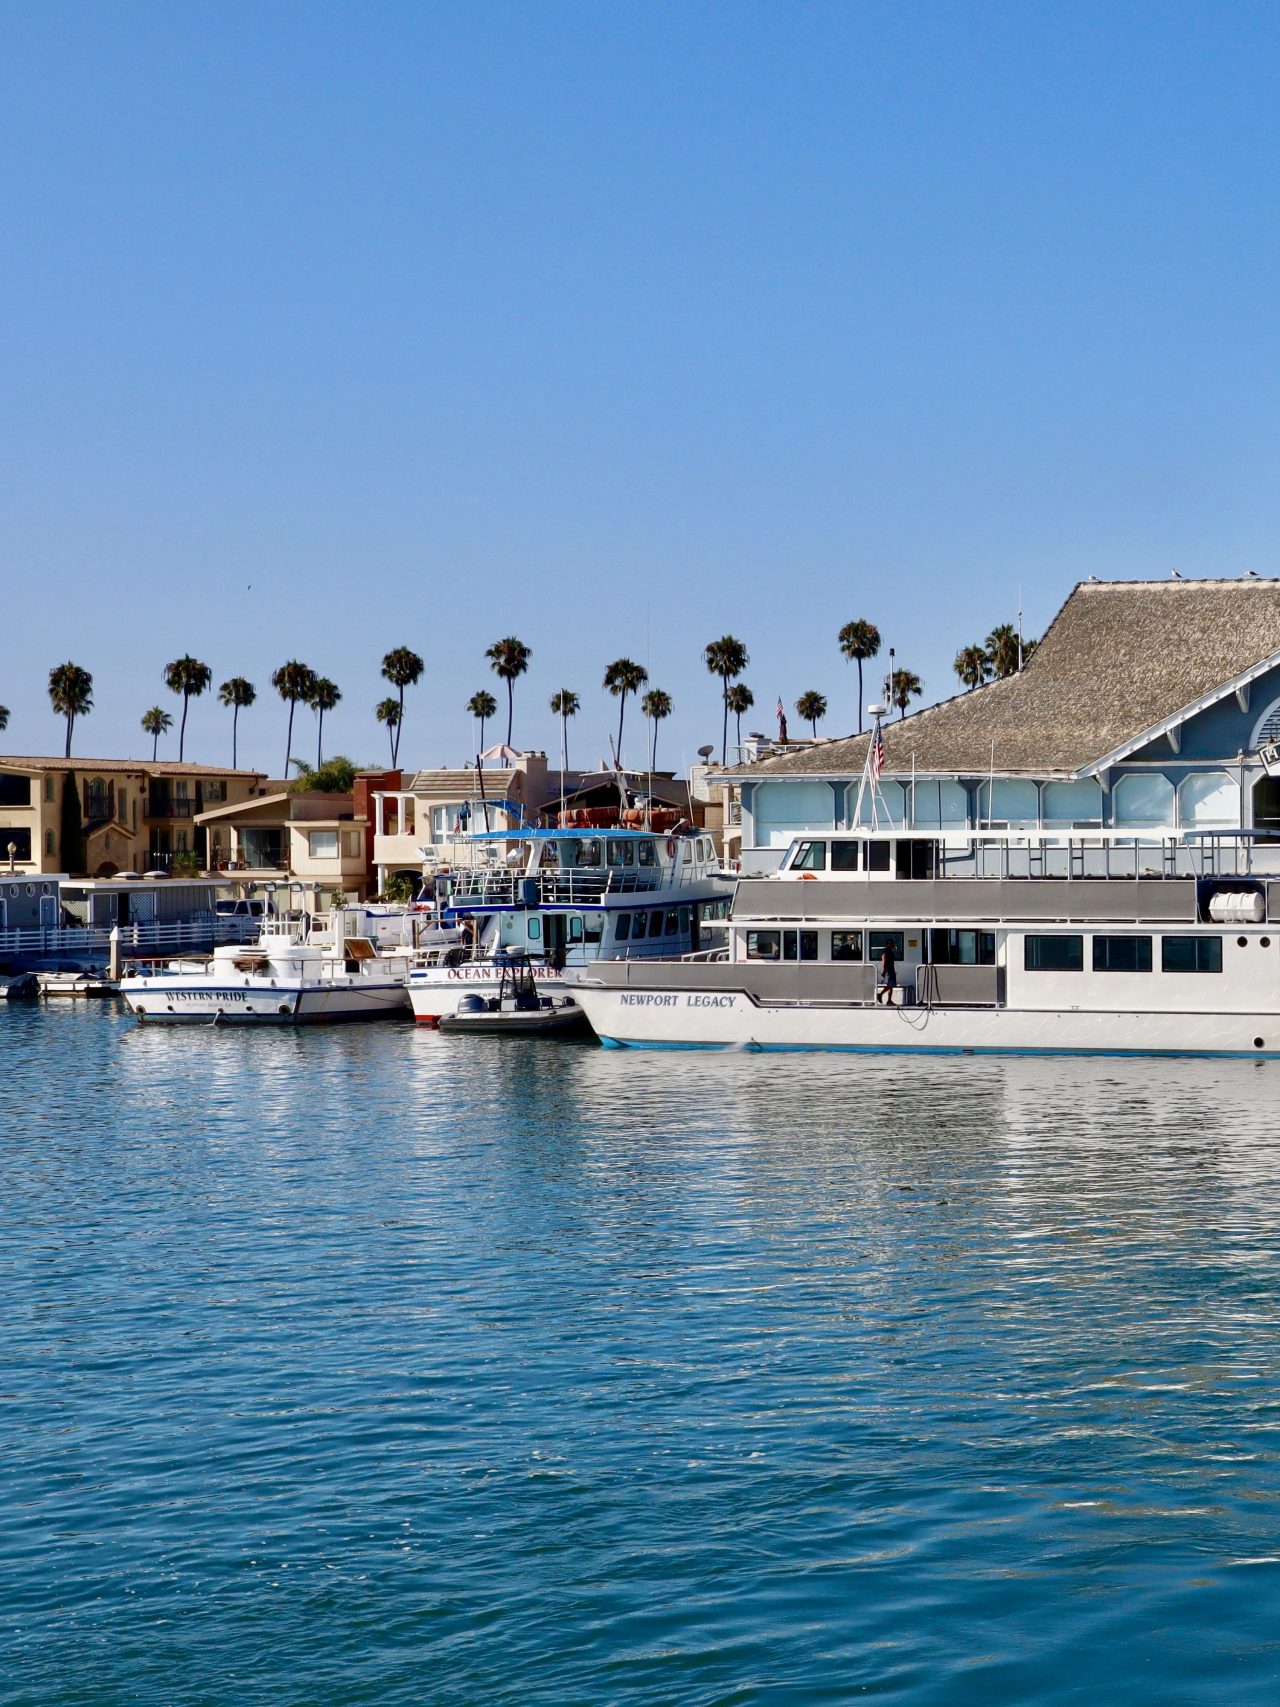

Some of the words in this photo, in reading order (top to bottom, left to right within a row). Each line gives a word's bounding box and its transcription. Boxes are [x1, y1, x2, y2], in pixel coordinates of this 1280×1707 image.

[447, 968, 491, 980] OCEAN
[165, 991, 212, 1001] WESTERN
[215, 991, 248, 1002] PRIDE
[620, 994, 679, 1007] NEWPORT
[686, 995, 737, 1008] LEGACY
